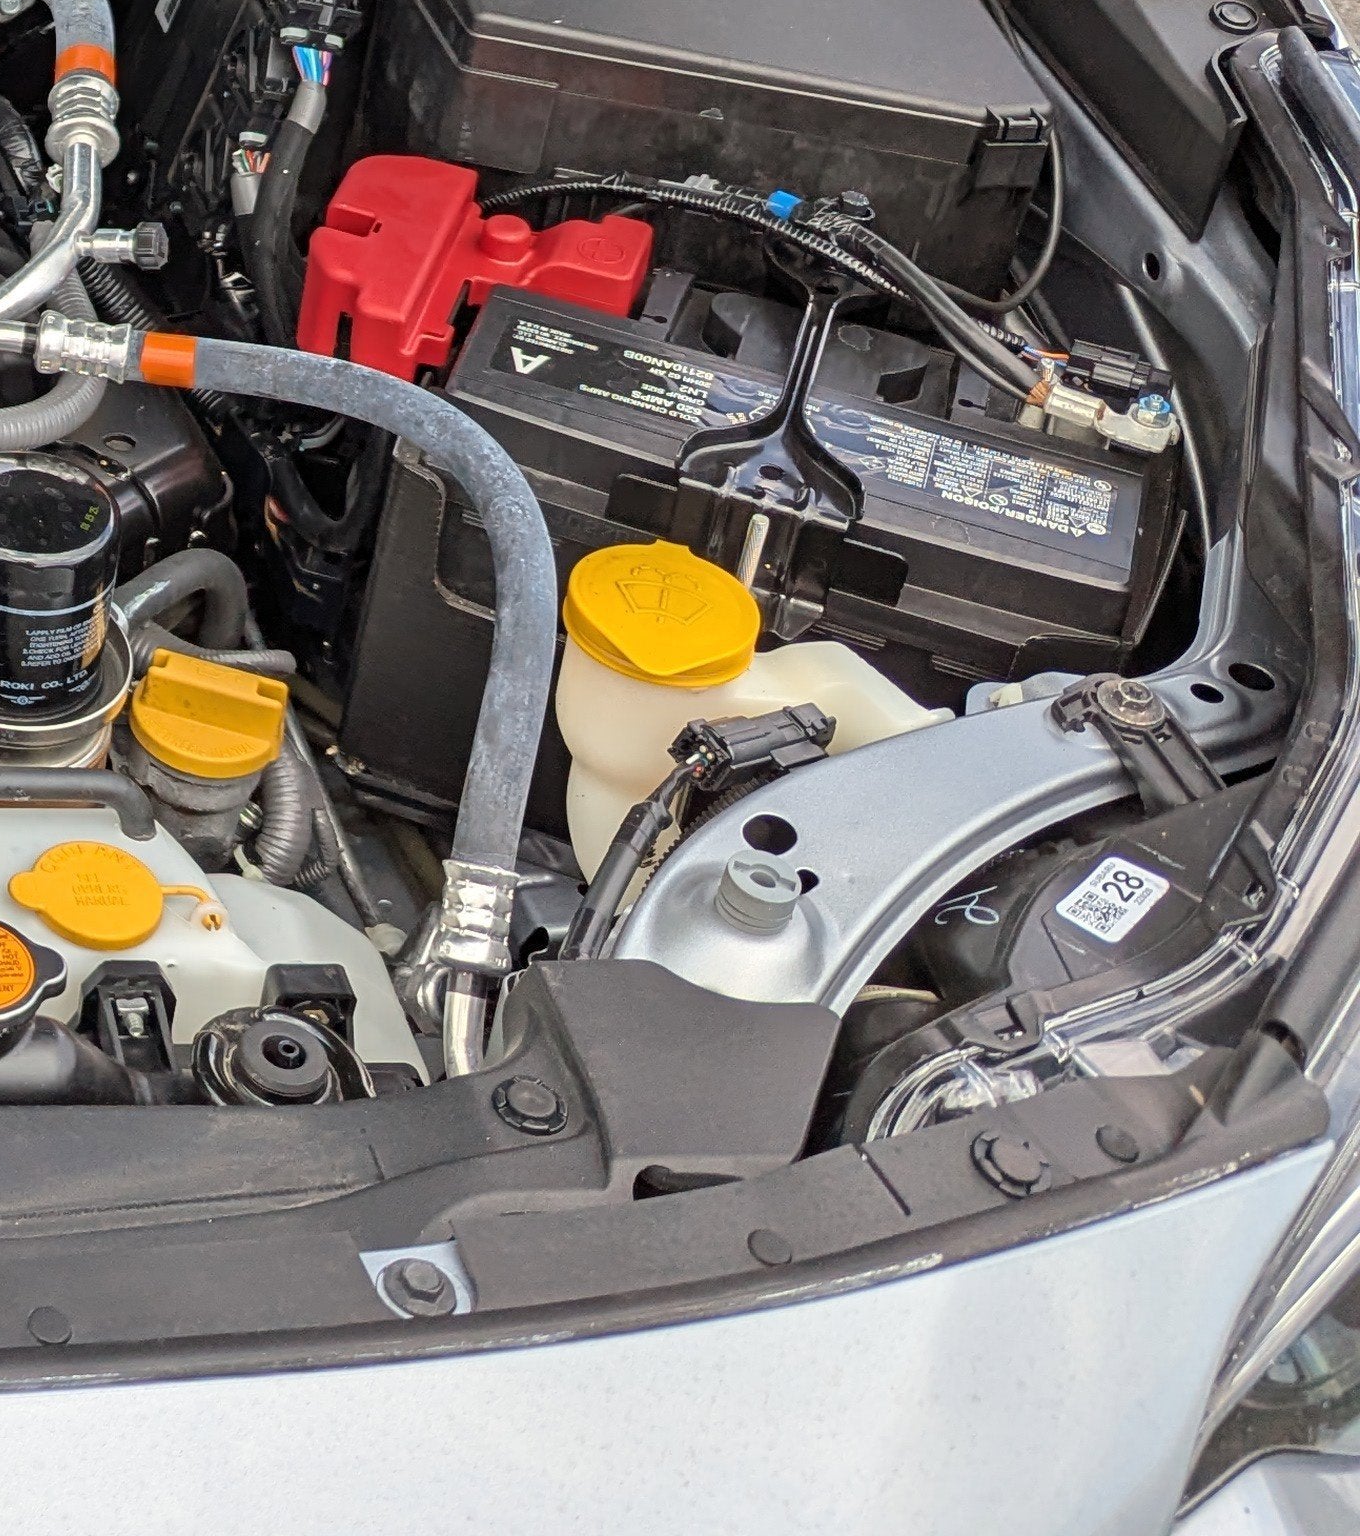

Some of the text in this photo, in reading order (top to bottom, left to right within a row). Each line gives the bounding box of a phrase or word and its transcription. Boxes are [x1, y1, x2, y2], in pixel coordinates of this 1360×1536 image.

[512, 347, 549, 373] A
[580, 385, 699, 423] COLD CRANKING AMPS
[632, 391, 702, 415] 620 AMPS
[642, 384, 704, 405] GROUP SIZE
[680, 385, 708, 398] LN2
[942, 491, 1068, 532] DANGER/POISON
[0, 679, 35, 691] ROKI
[1102, 870, 1144, 903] 28
